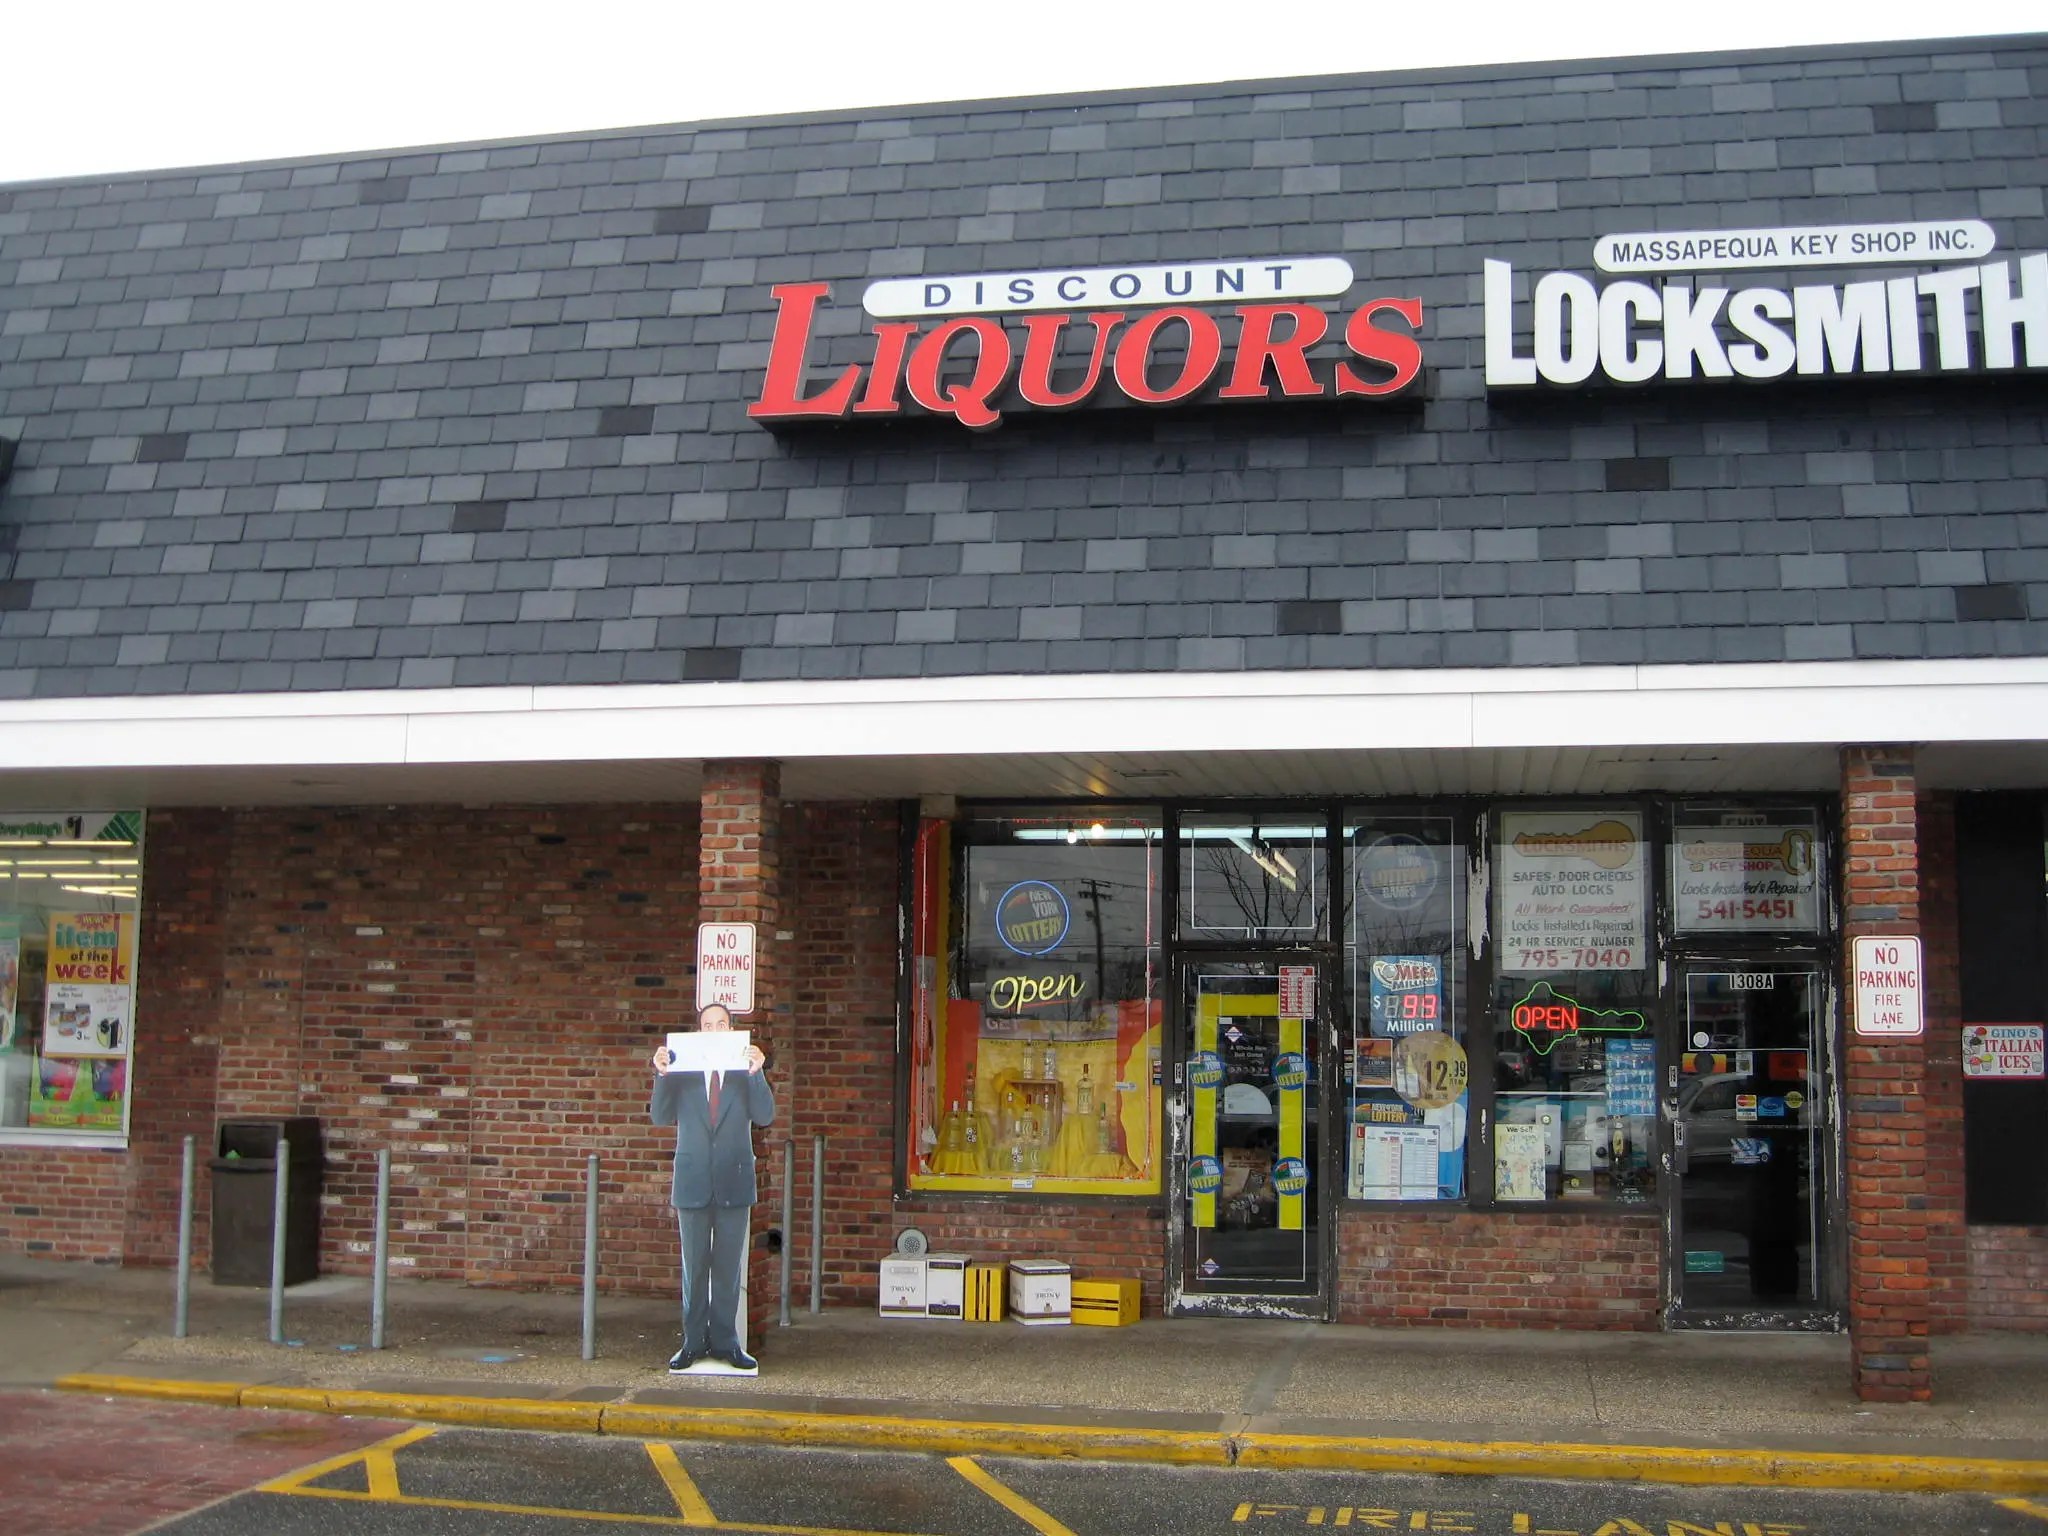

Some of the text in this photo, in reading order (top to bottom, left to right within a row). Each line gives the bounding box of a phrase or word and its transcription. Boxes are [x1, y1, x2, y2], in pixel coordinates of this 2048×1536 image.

[1612, 229, 1975, 263] MASSAPEQUA KEY SHOP INC.
[924, 265, 1292, 308] DISCOUNT
[746, 282, 1423, 427] LIQUORS
[1709, 861, 1775, 872] KEY SHOP
[1513, 871, 1634, 882] SAFES DOOR CHECKS
[1532, 884, 1614, 896] AUTO LOCKS
[1681, 881, 1709, 895] Locks
[1029, 890, 1053, 902] NEW
[1032, 901, 1060, 918] YORK
[1515, 903, 1531, 914] All
[1536, 903, 1565, 914] Work
[1698, 900, 1795, 919] 541-5451
[1006, 916, 1063, 943] LOTTERY
[1512, 919, 1540, 931] Locks
[1592, 919, 1634, 934] Repaired
[55, 922, 117, 949] item
[716, 933, 737, 950] NO
[1526, 937, 1540, 947] HR
[1545, 937, 1584, 947] SERVICE
[1591, 937, 1635, 947] NUMBER
[70, 950, 109, 961] of the
[703, 955, 750, 971] PARKING
[1519, 949, 1632, 968] 795-7040
[1875, 947, 1899, 965] NO
[55, 964, 127, 979] week
[1393, 965, 1436, 980] MEGA
[1859, 970, 1916, 988] PARKING
[714, 975, 737, 987] FIRE
[1731, 974, 1773, 989] 1308A
[712, 992, 738, 1004] LANE
[990, 973, 1087, 1014] Open
[1875, 994, 1902, 1006] FIRE
[1514, 1005, 1579, 1030] OPEN
[1873, 1012, 1904, 1024] LANE
[1386, 1020, 1435, 1032] Million
[1991, 1028, 2038, 1038] GINO'S
[1984, 1039, 2043, 1053] ITALIAN
[1998, 1054, 2031, 1069] ICES
[1372, 1111, 1408, 1123] LOTTERY
[1232, 1502, 1475, 1533] FIRE
